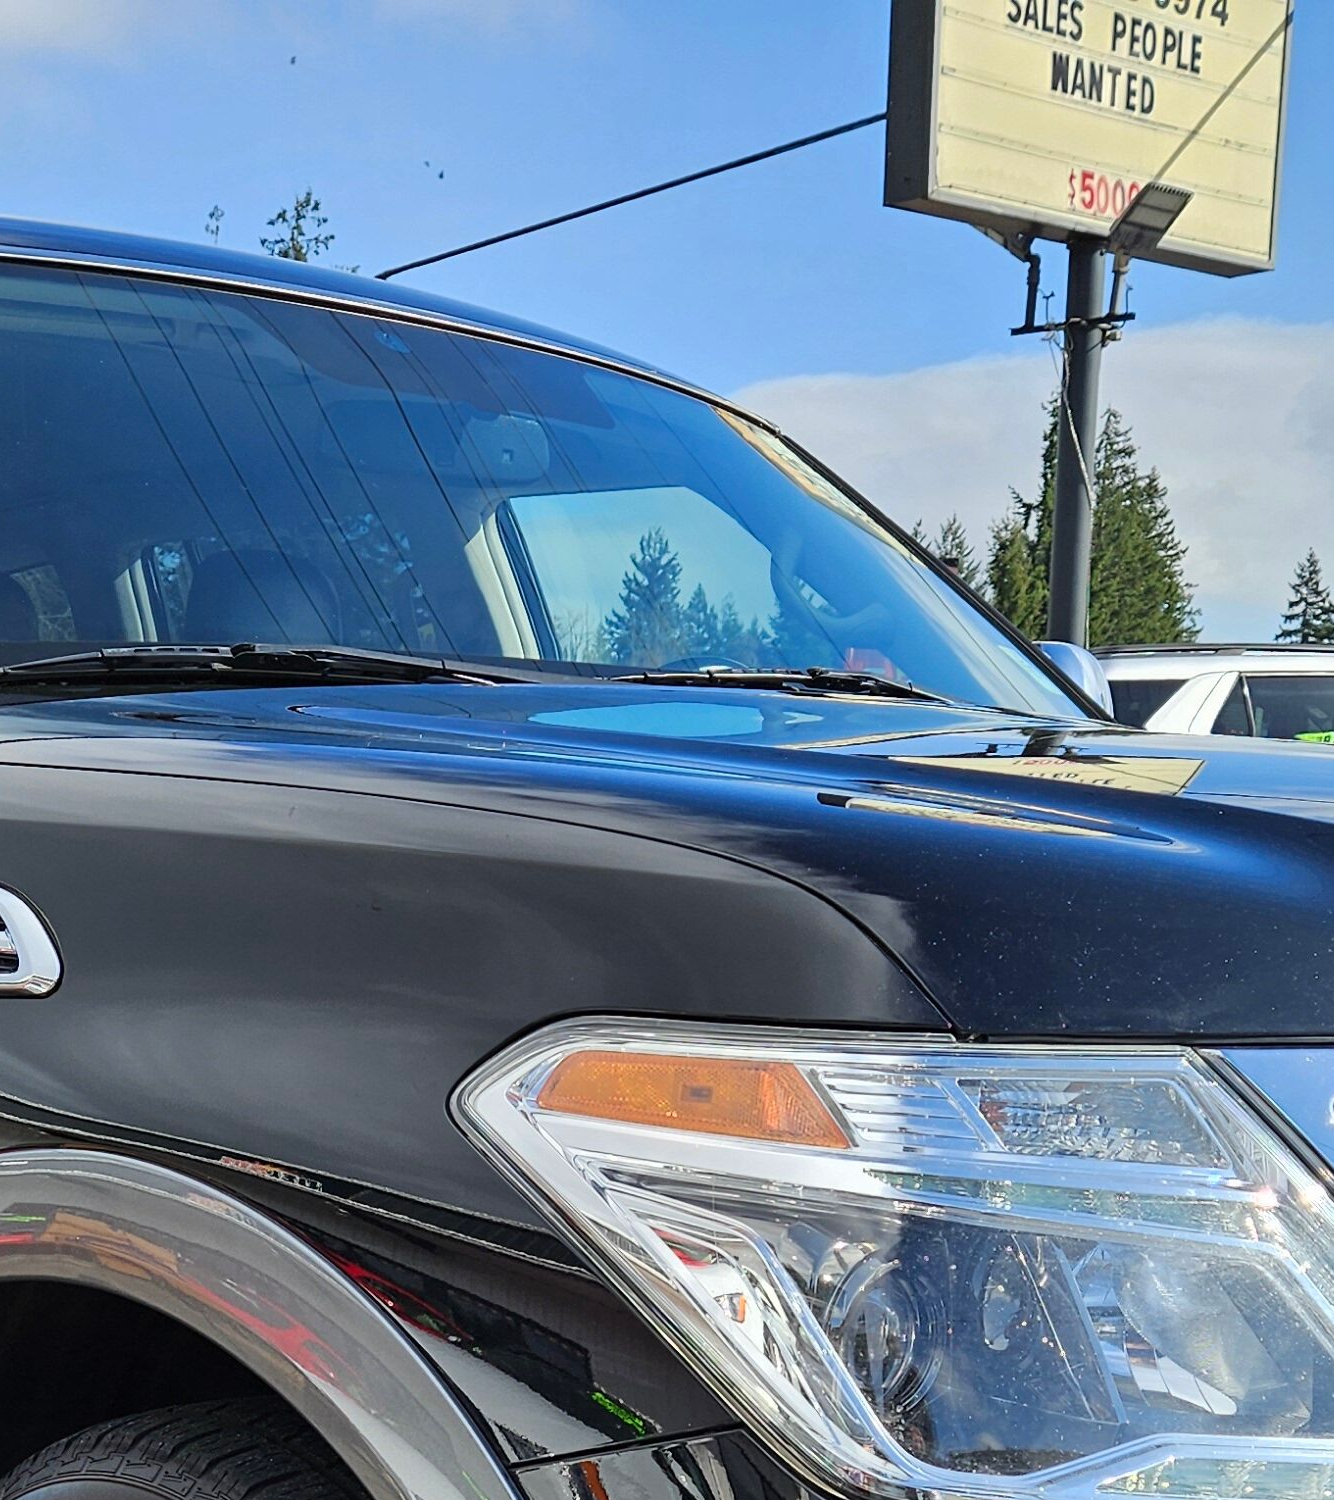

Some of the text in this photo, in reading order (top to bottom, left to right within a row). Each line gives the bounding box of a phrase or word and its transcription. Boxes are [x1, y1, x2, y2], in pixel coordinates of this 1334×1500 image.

[1007, 0, 1203, 74] SALES PEOPLE
[1051, 51, 1155, 115] WANTED
